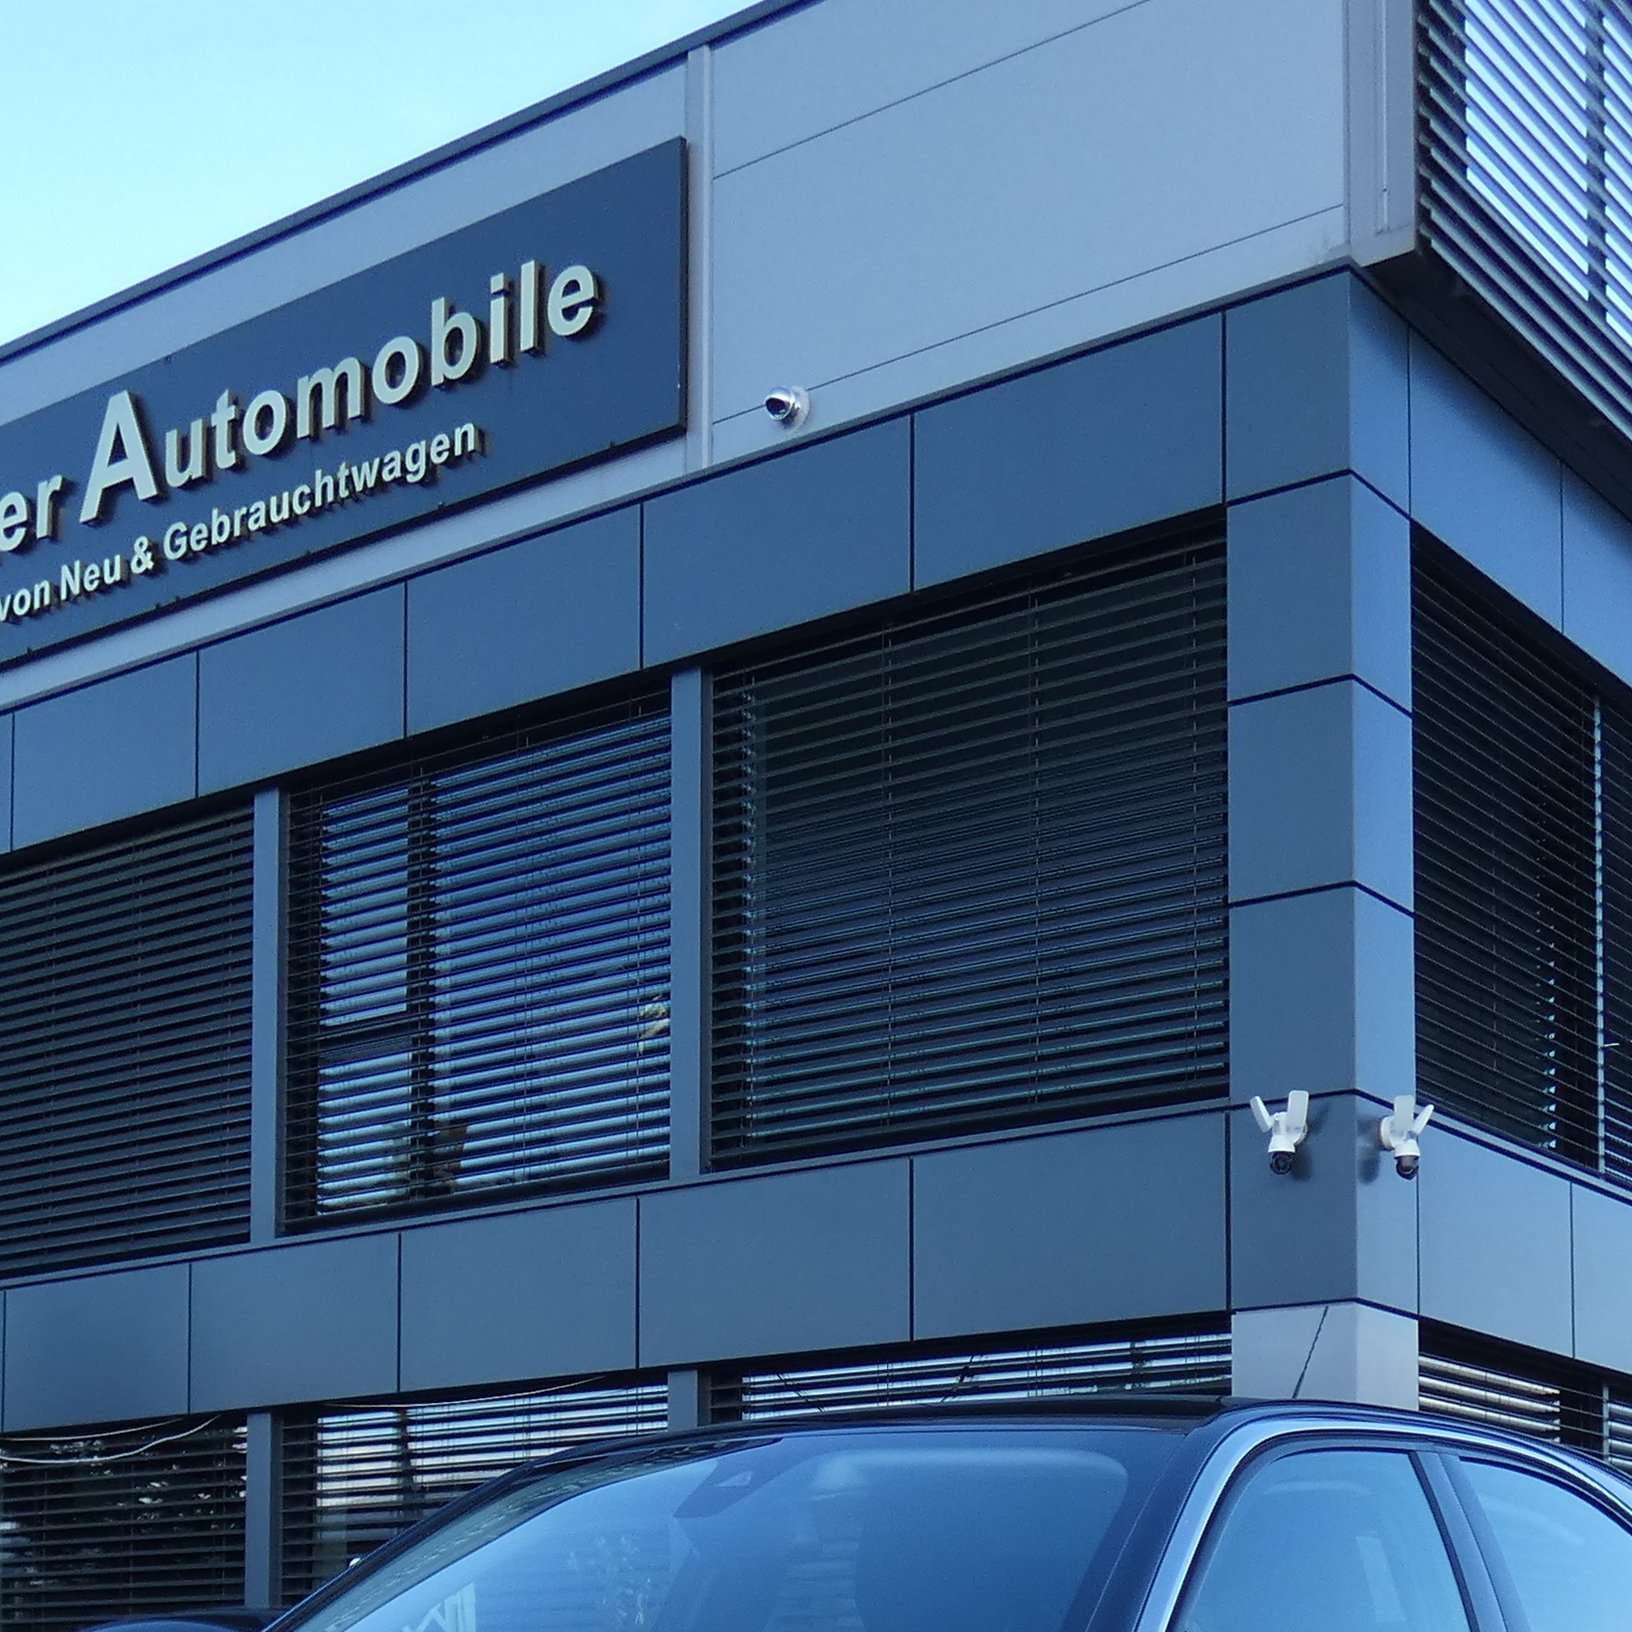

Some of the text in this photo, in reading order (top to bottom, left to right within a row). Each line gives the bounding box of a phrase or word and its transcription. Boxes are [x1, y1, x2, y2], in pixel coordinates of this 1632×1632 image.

[79, 260, 600, 524] Automobile
[58, 553, 123, 602] Neu
[129, 536, 156, 576] &
[162, 422, 478, 561] Gebrauchtwagen
